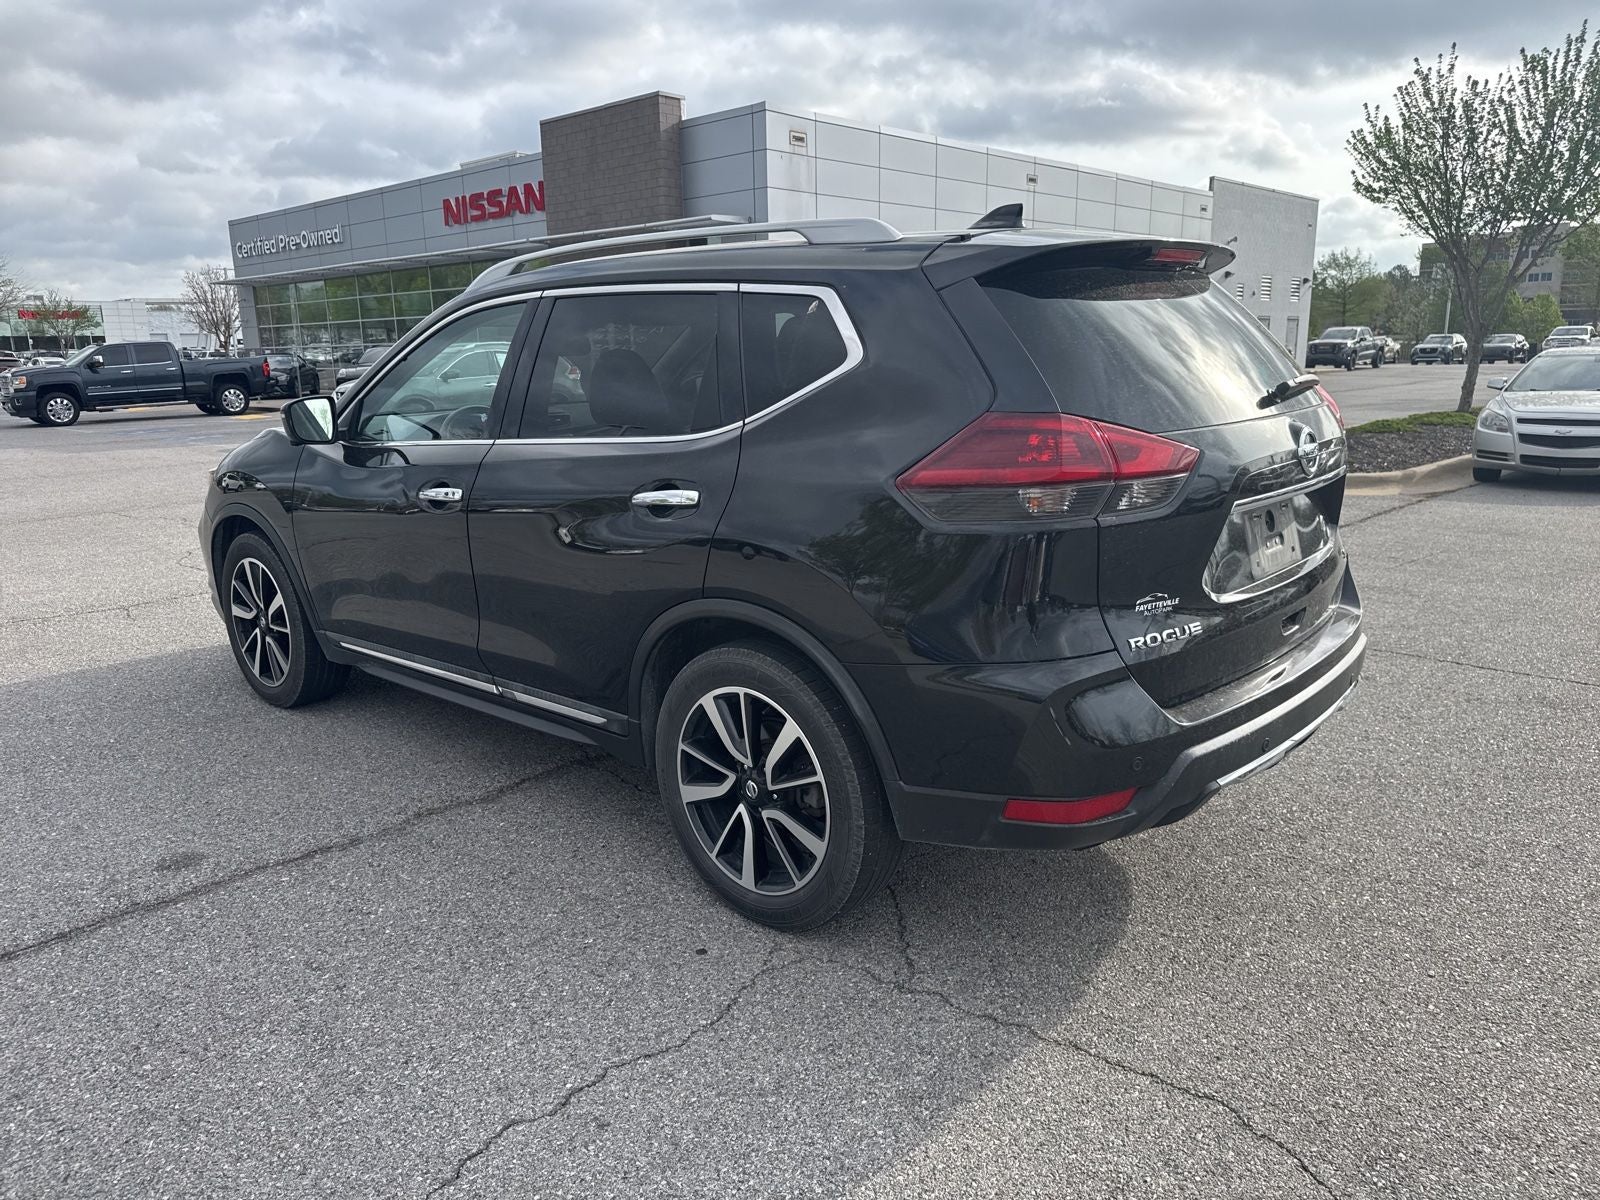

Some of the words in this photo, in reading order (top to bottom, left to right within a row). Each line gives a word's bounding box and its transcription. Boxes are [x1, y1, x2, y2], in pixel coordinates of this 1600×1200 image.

[442, 180, 546, 227] NISSAN
[235, 233, 277, 258] Certified
[278, 223, 343, 252] Pre-Owned
[1135, 597, 1180, 612] FAYETTEVILLE
[1143, 606, 1173, 616] AUTOPARK
[1127, 621, 1203, 652] ROGUE
